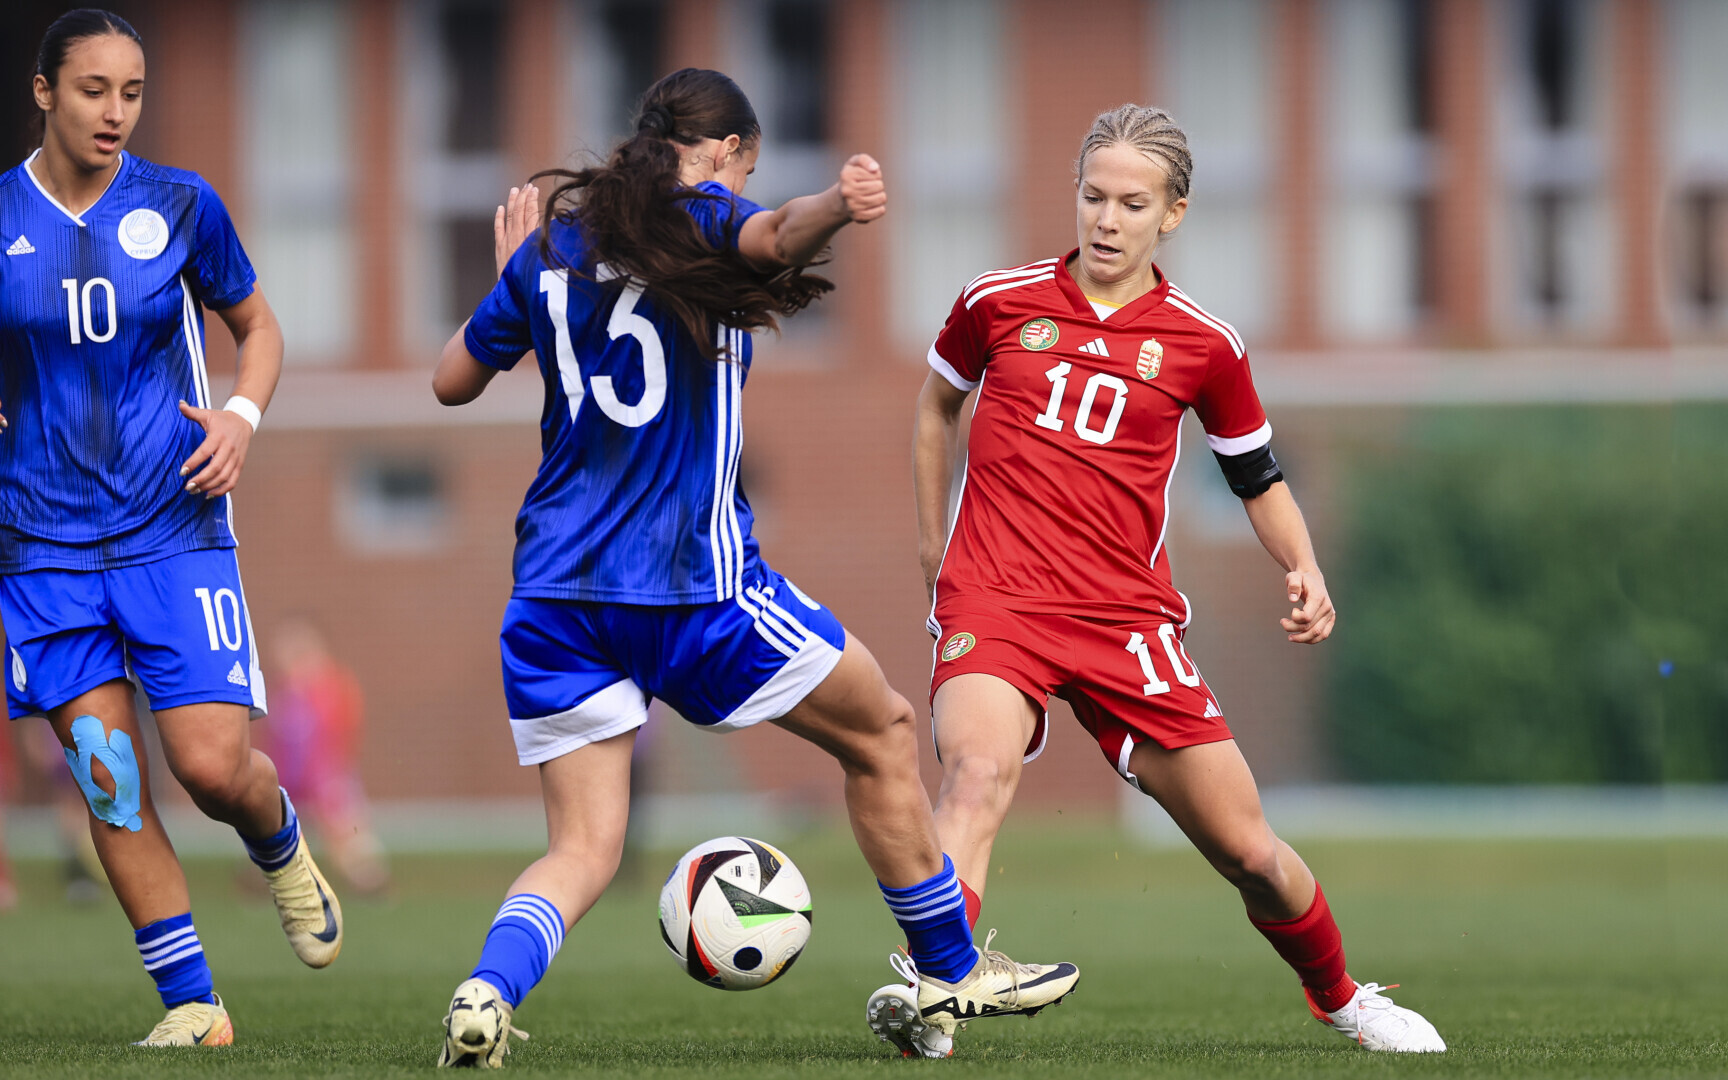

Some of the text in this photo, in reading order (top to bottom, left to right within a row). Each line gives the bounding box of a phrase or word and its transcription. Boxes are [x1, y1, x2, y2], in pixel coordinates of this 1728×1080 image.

[6, 246, 35, 255] adidas
[130, 248, 158, 256] CYPRUS
[62, 277, 118, 345] 10
[1035, 361, 1129, 445] 10
[194, 587, 242, 652] 10
[1125, 622, 1201, 697] 10
